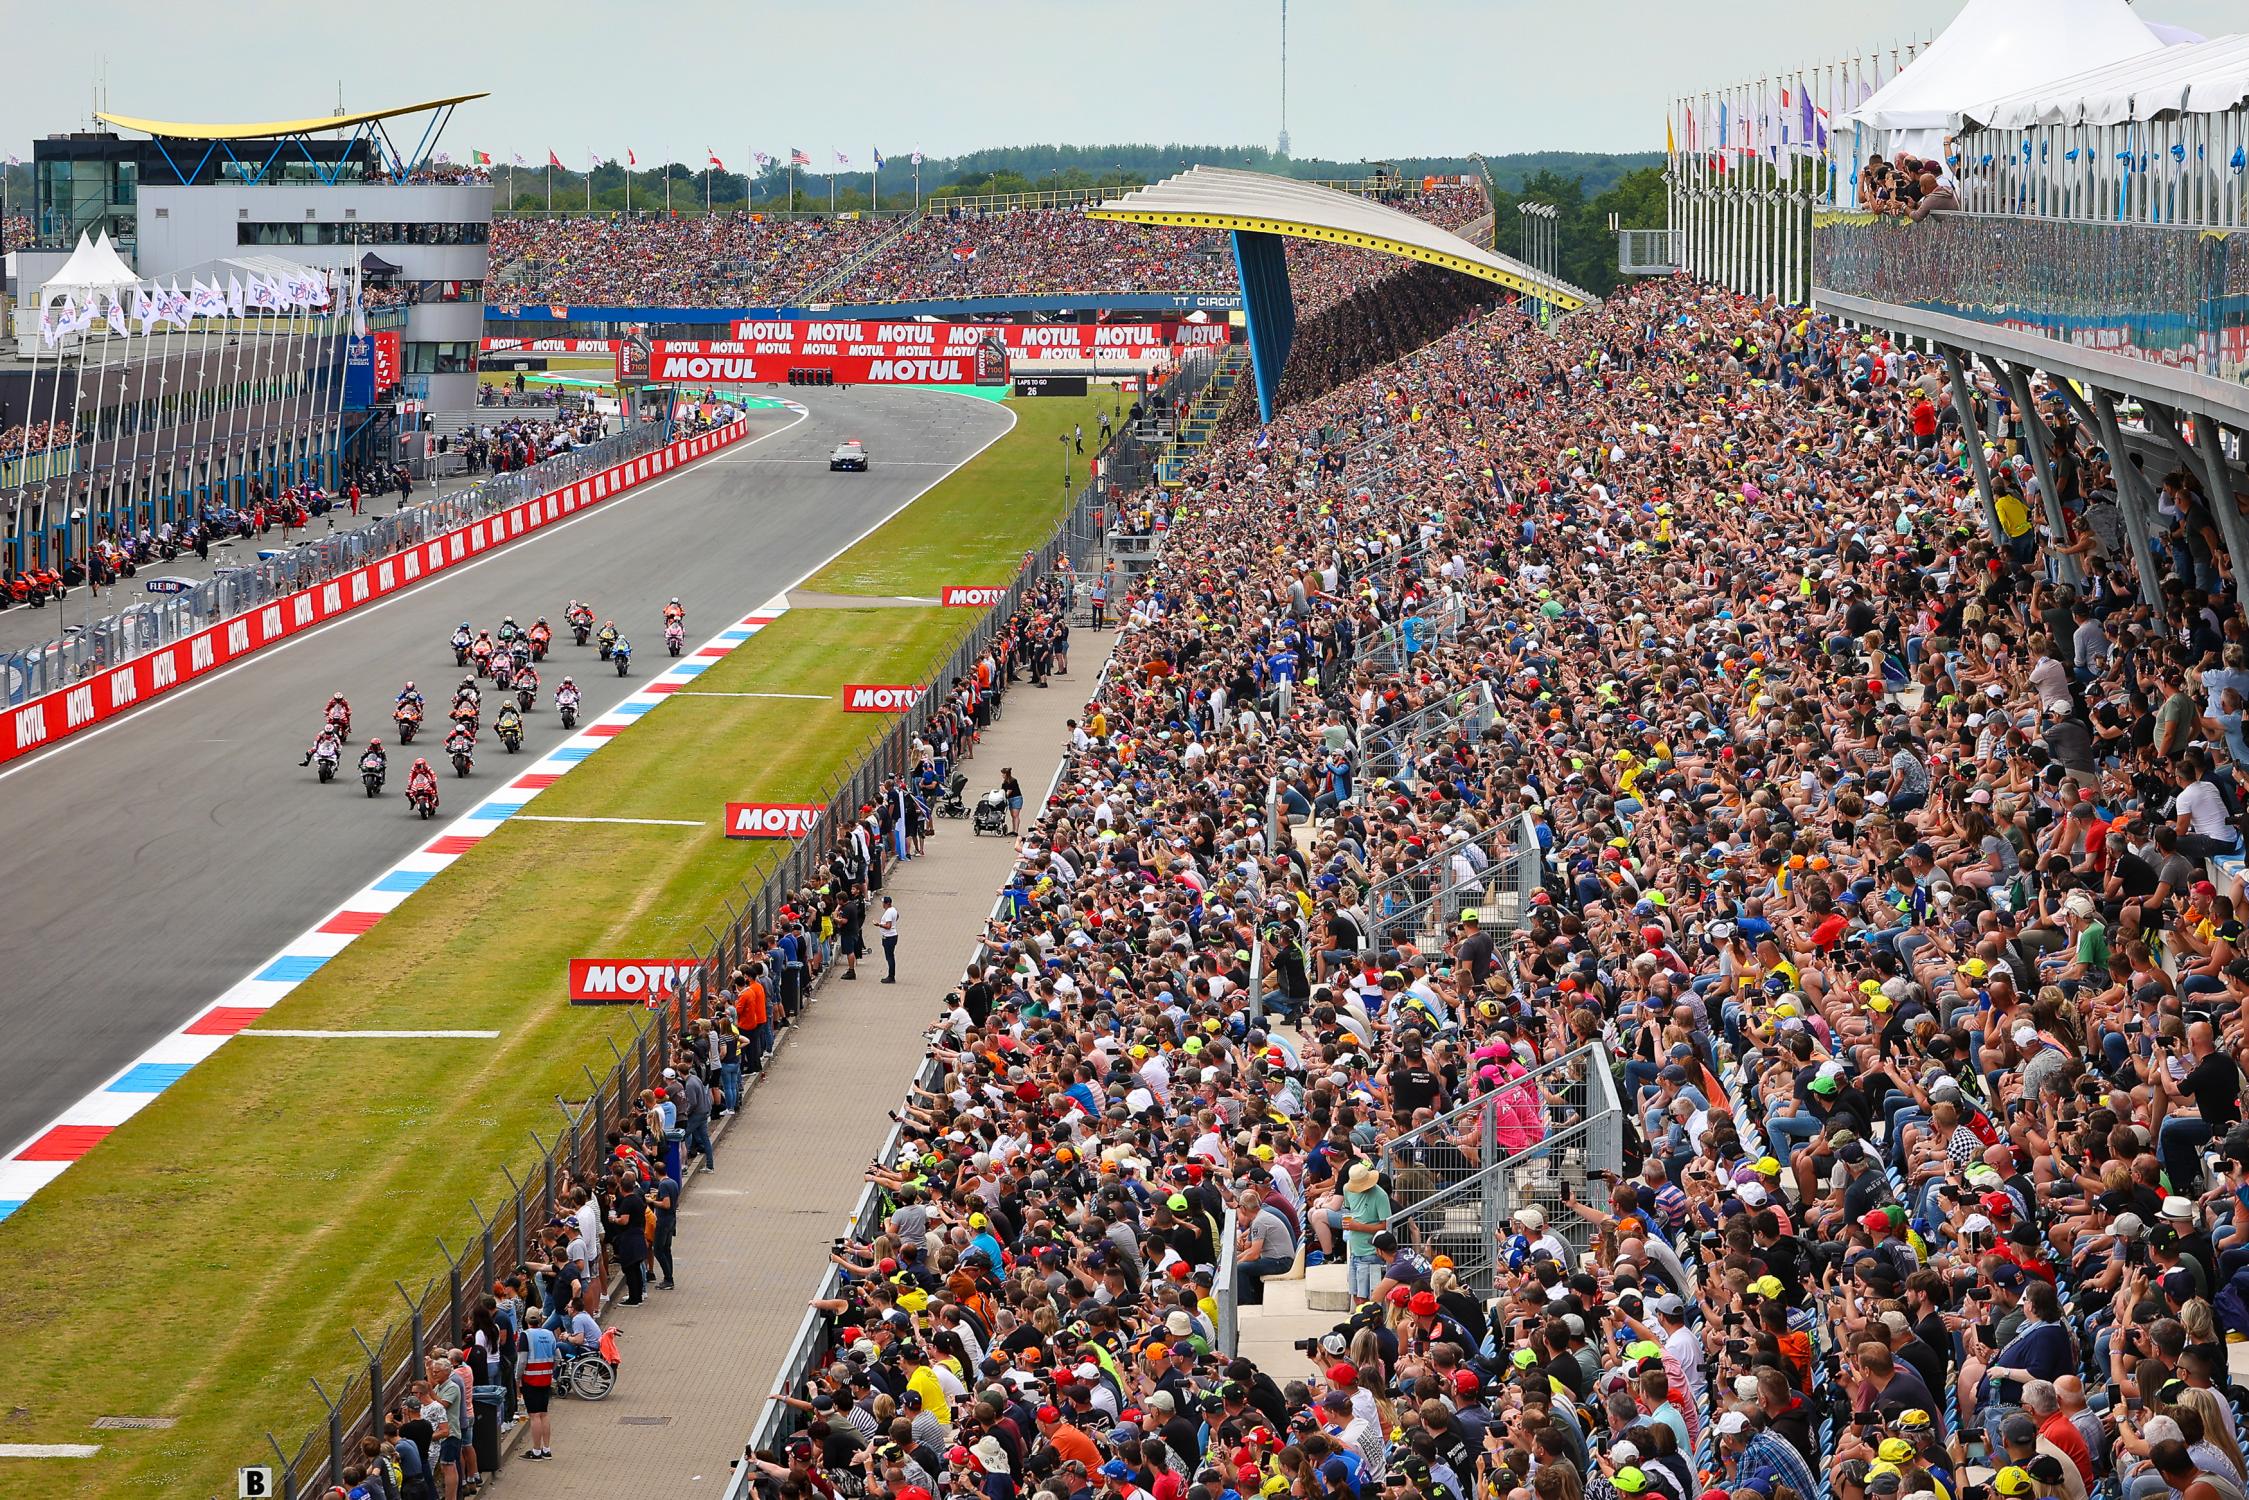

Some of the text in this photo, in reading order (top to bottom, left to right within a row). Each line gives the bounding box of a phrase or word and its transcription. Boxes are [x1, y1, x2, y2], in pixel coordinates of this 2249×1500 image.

[1172, 296, 1242, 307] TT CIRCUIT
[738, 322, 1157, 346] MOTUL MOTUL MOTUL MOTL MOTUL MOTUL
[1175, 325, 1224, 345] MOTUL
[489, 338, 610, 353] MOTUL MOTUL MOTUL
[665, 341, 700, 354] MOTUL
[710, 342, 745, 355] MOTUL
[756, 342, 792, 355] MOTUL
[802, 343, 838, 356] MOTUL
[847, 344, 885, 357] MOTUL
[896, 345, 933, 358] MOTUL
[943, 346, 976, 358] MOTU
[1040, 347, 1081, 360] MOTUL
[1140, 347, 1171, 360] MOTU
[631, 363, 647, 371] 7100
[662, 357, 757, 379] MOTUL
[868, 359, 963, 381] MOTUL
[979, 348, 987, 376] MOTUL
[987, 366, 1003, 374] 7100
[1027, 386, 1037, 396] 26
[948, 589, 1007, 605] MOTU
[16, 704, 46, 749] MOTUL
[67, 685, 94, 728] MOTUL
[112, 666, 137, 707] MOTUL
[153, 650, 176, 689] MOTUL
[192, 634, 214, 672] MOTUL
[228, 618, 249, 655] MOTUL
[263, 604, 283, 640] MOTUL
[851, 689, 926, 708] MOTU
[736, 808, 824, 831] MOTU
[246, 1470, 265, 1496] B
